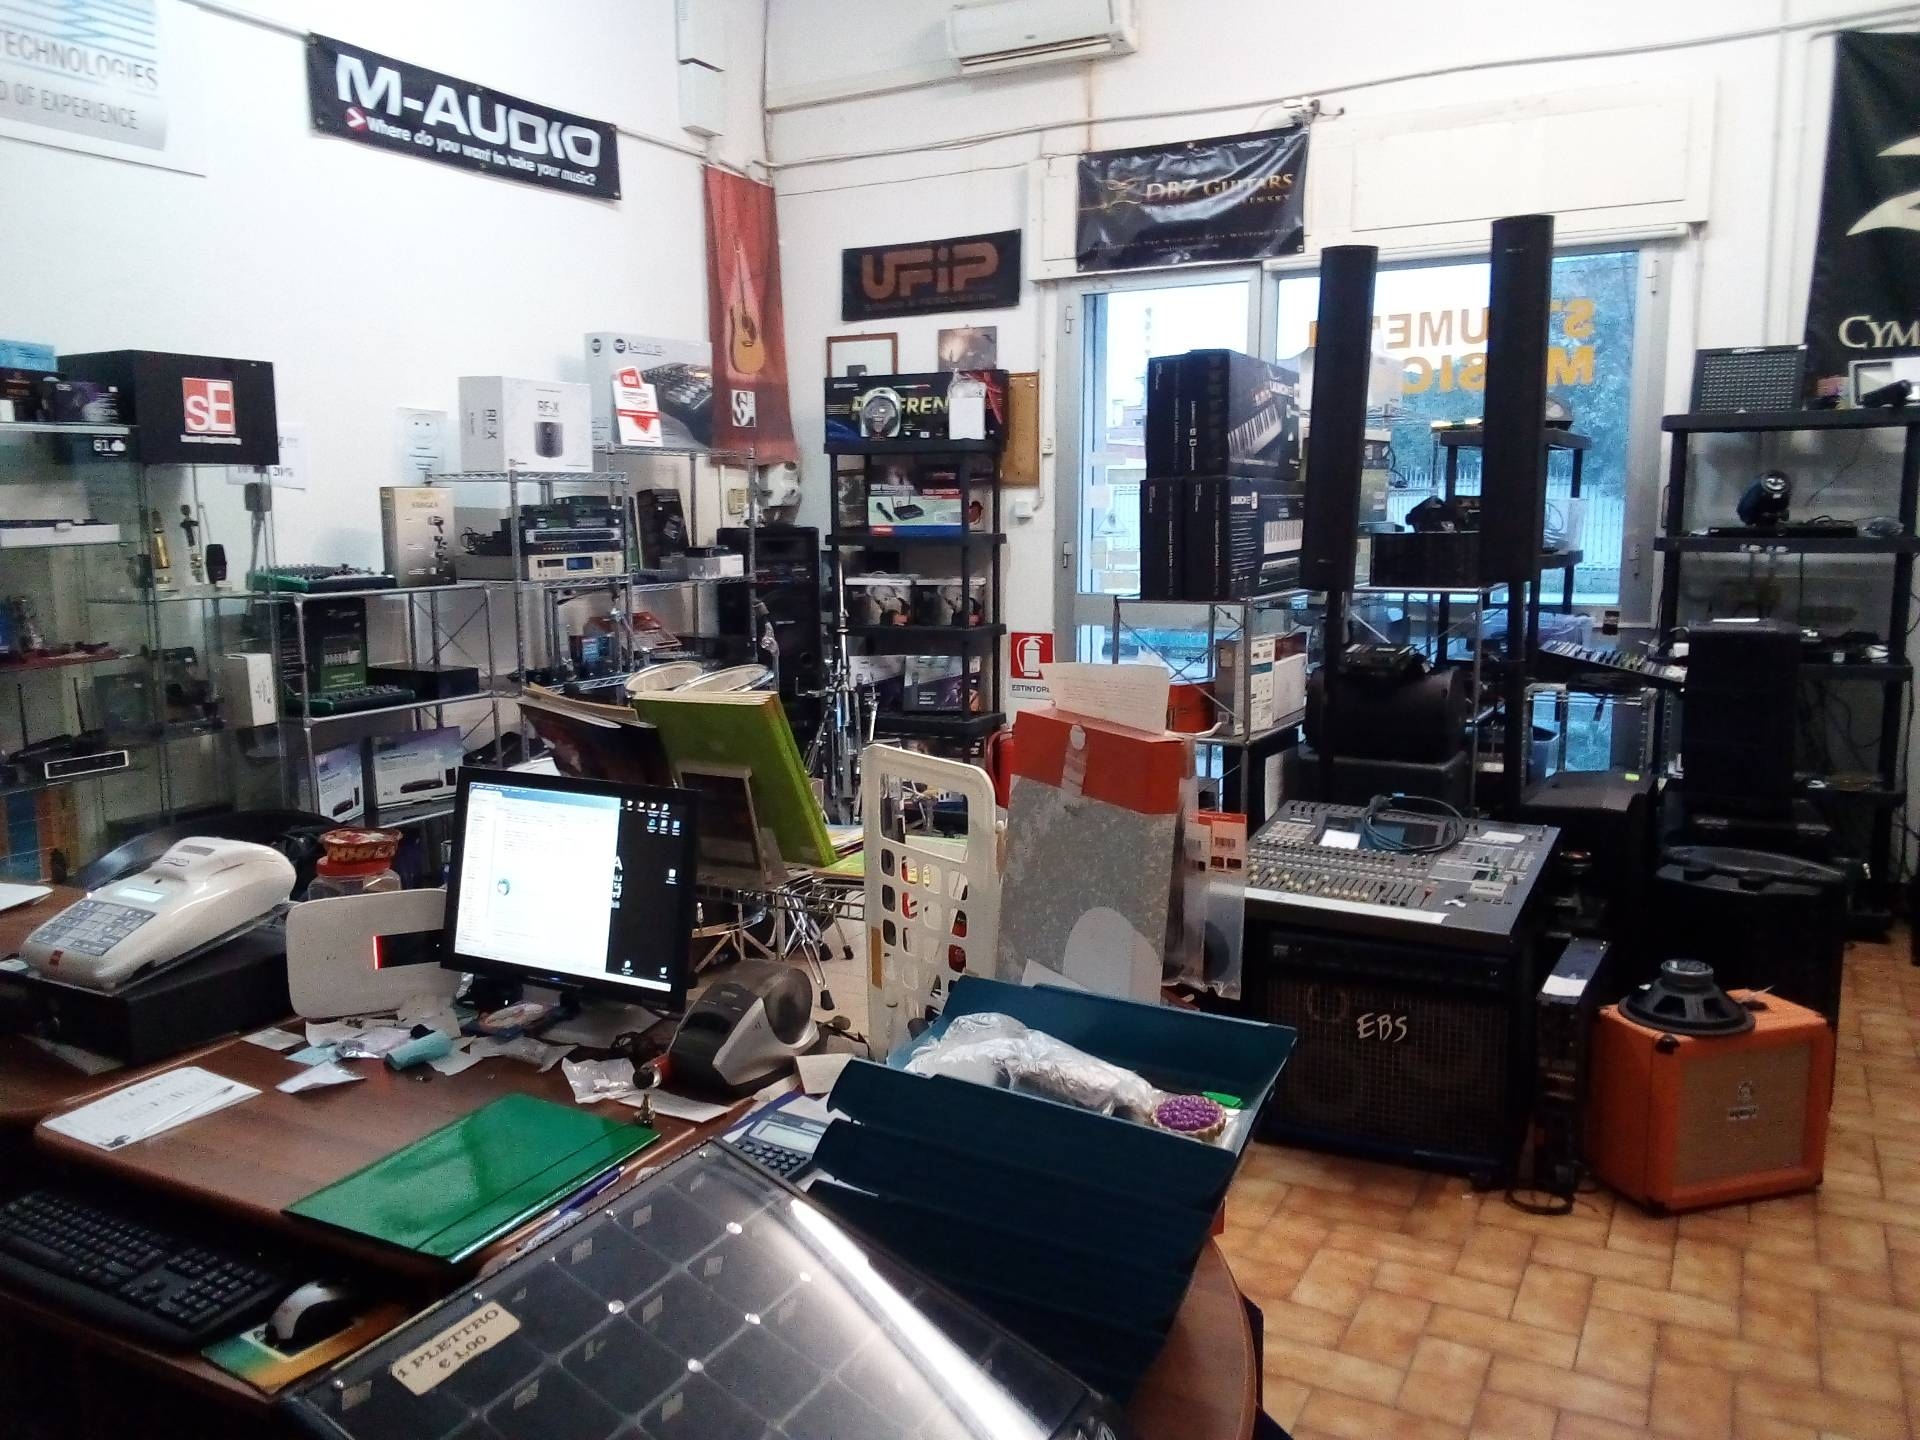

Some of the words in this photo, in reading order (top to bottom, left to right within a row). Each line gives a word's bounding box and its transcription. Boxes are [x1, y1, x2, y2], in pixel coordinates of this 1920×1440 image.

[0, 29, 159, 91] ECHNOLOGIES
[41, 89, 139, 130] EXPERIENCE
[336, 53, 601, 168] M-AUDIO
[366, 115, 412, 142] Where
[413, 130, 435, 147] do
[436, 137, 463, 154] you
[462, 144, 491, 161] want
[492, 149, 507, 166] to
[507, 154, 536, 172] take
[536, 162, 561, 178] your
[560, 169, 596, 187] music?
[1356, 1012, 1408, 1042] EBS
[410, 1308, 500, 1368] PLETTRO
[454, 1334, 487, 1361] 1,00
